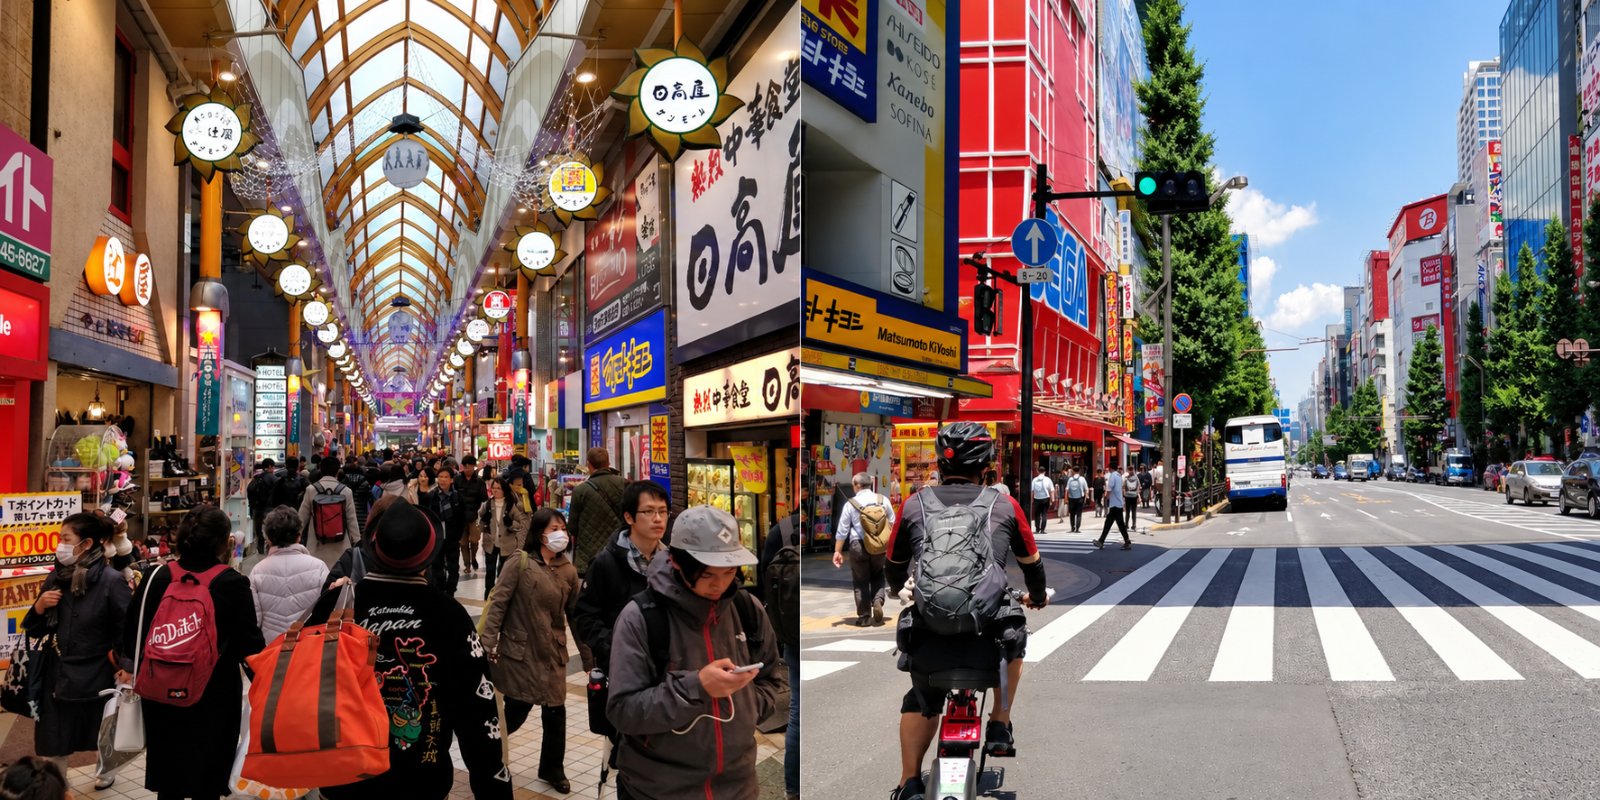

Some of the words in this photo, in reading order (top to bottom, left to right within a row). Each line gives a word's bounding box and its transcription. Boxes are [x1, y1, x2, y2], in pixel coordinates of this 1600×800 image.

[653, 79, 710, 101] 日高屋
[886, 72, 935, 118] Kanebo
[890, 102, 933, 142] SOFINA
[878, 327, 928, 351] Matsumoto
[929, 340, 957, 358] KiYoshi
[8, 497, 77, 512] Tポイントカード
[360, 618, 423, 636] Japan
